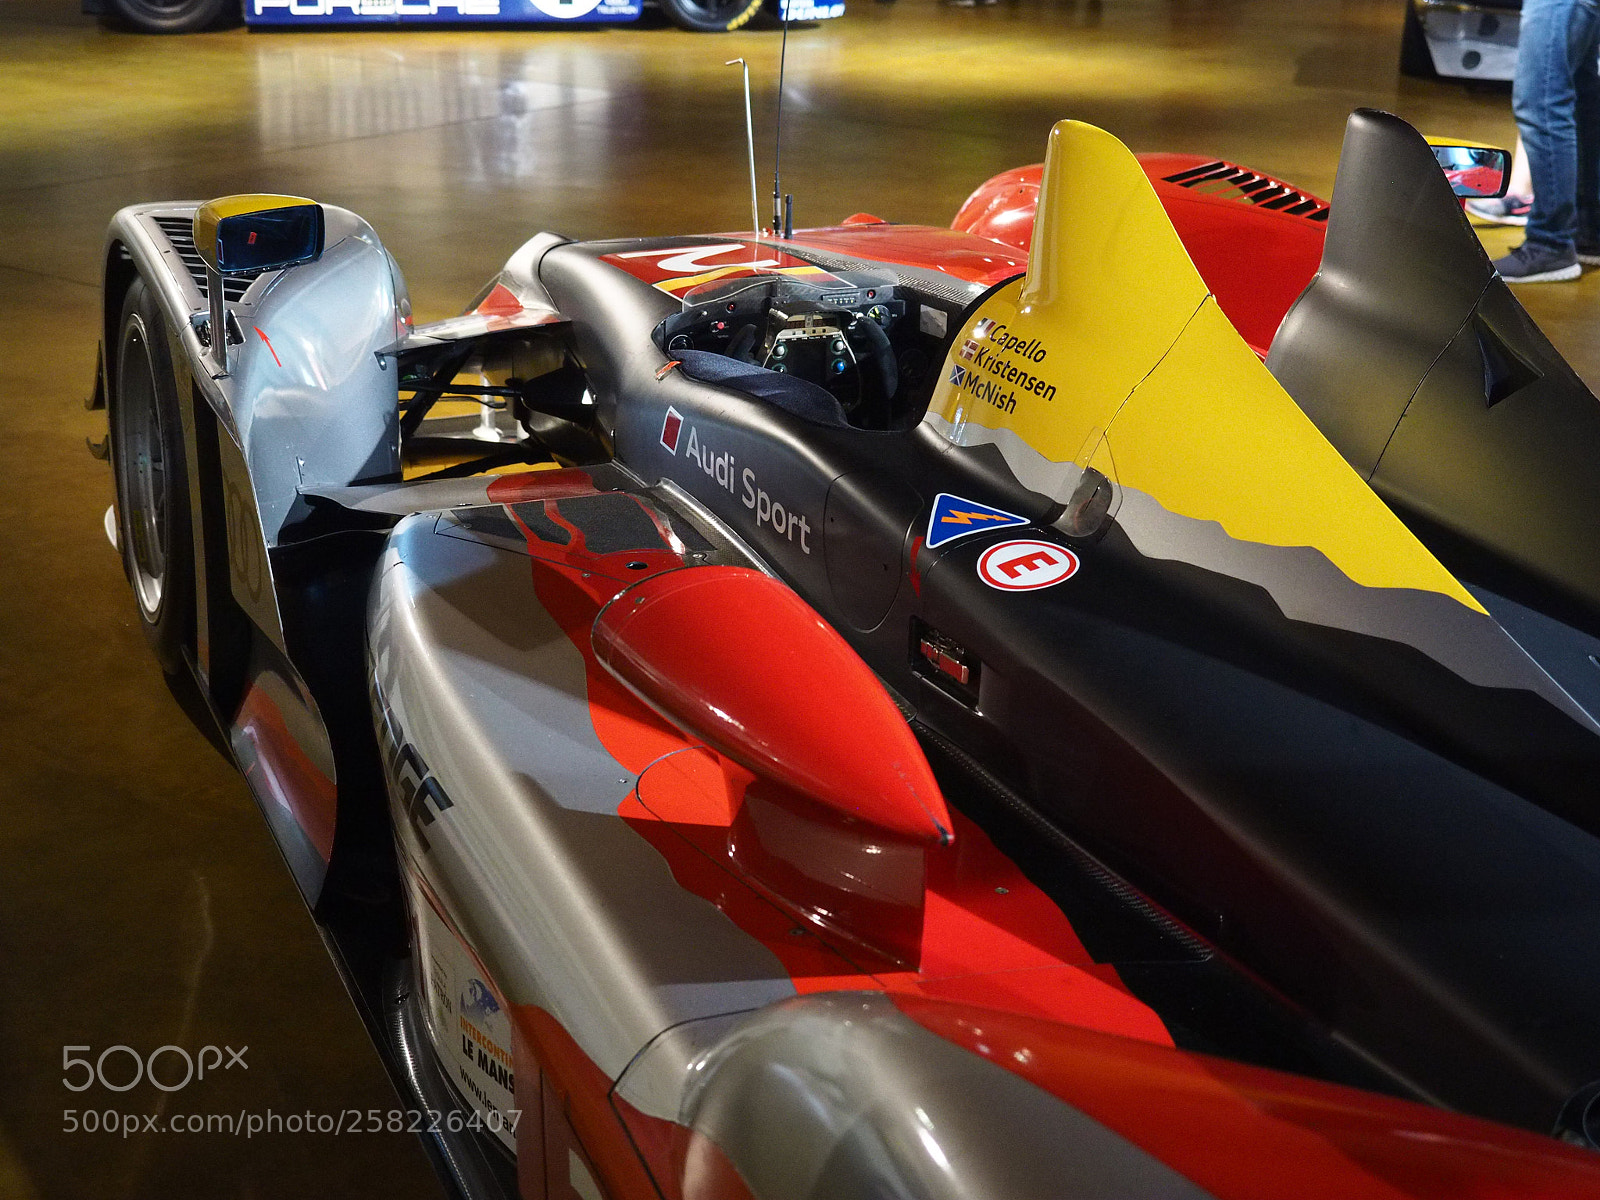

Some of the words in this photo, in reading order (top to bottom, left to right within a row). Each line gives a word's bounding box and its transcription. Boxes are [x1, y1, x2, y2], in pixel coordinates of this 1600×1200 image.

[989, 325, 1047, 363] Capello
[963, 371, 1017, 414] McNish
[973, 346, 1057, 401] Kristensen
[685, 426, 735, 494] Audi
[741, 467, 811, 554] Sport
[996, 550, 1060, 579] E
[462, 1034, 474, 1061] LE
[478, 1048, 515, 1095] MANS
